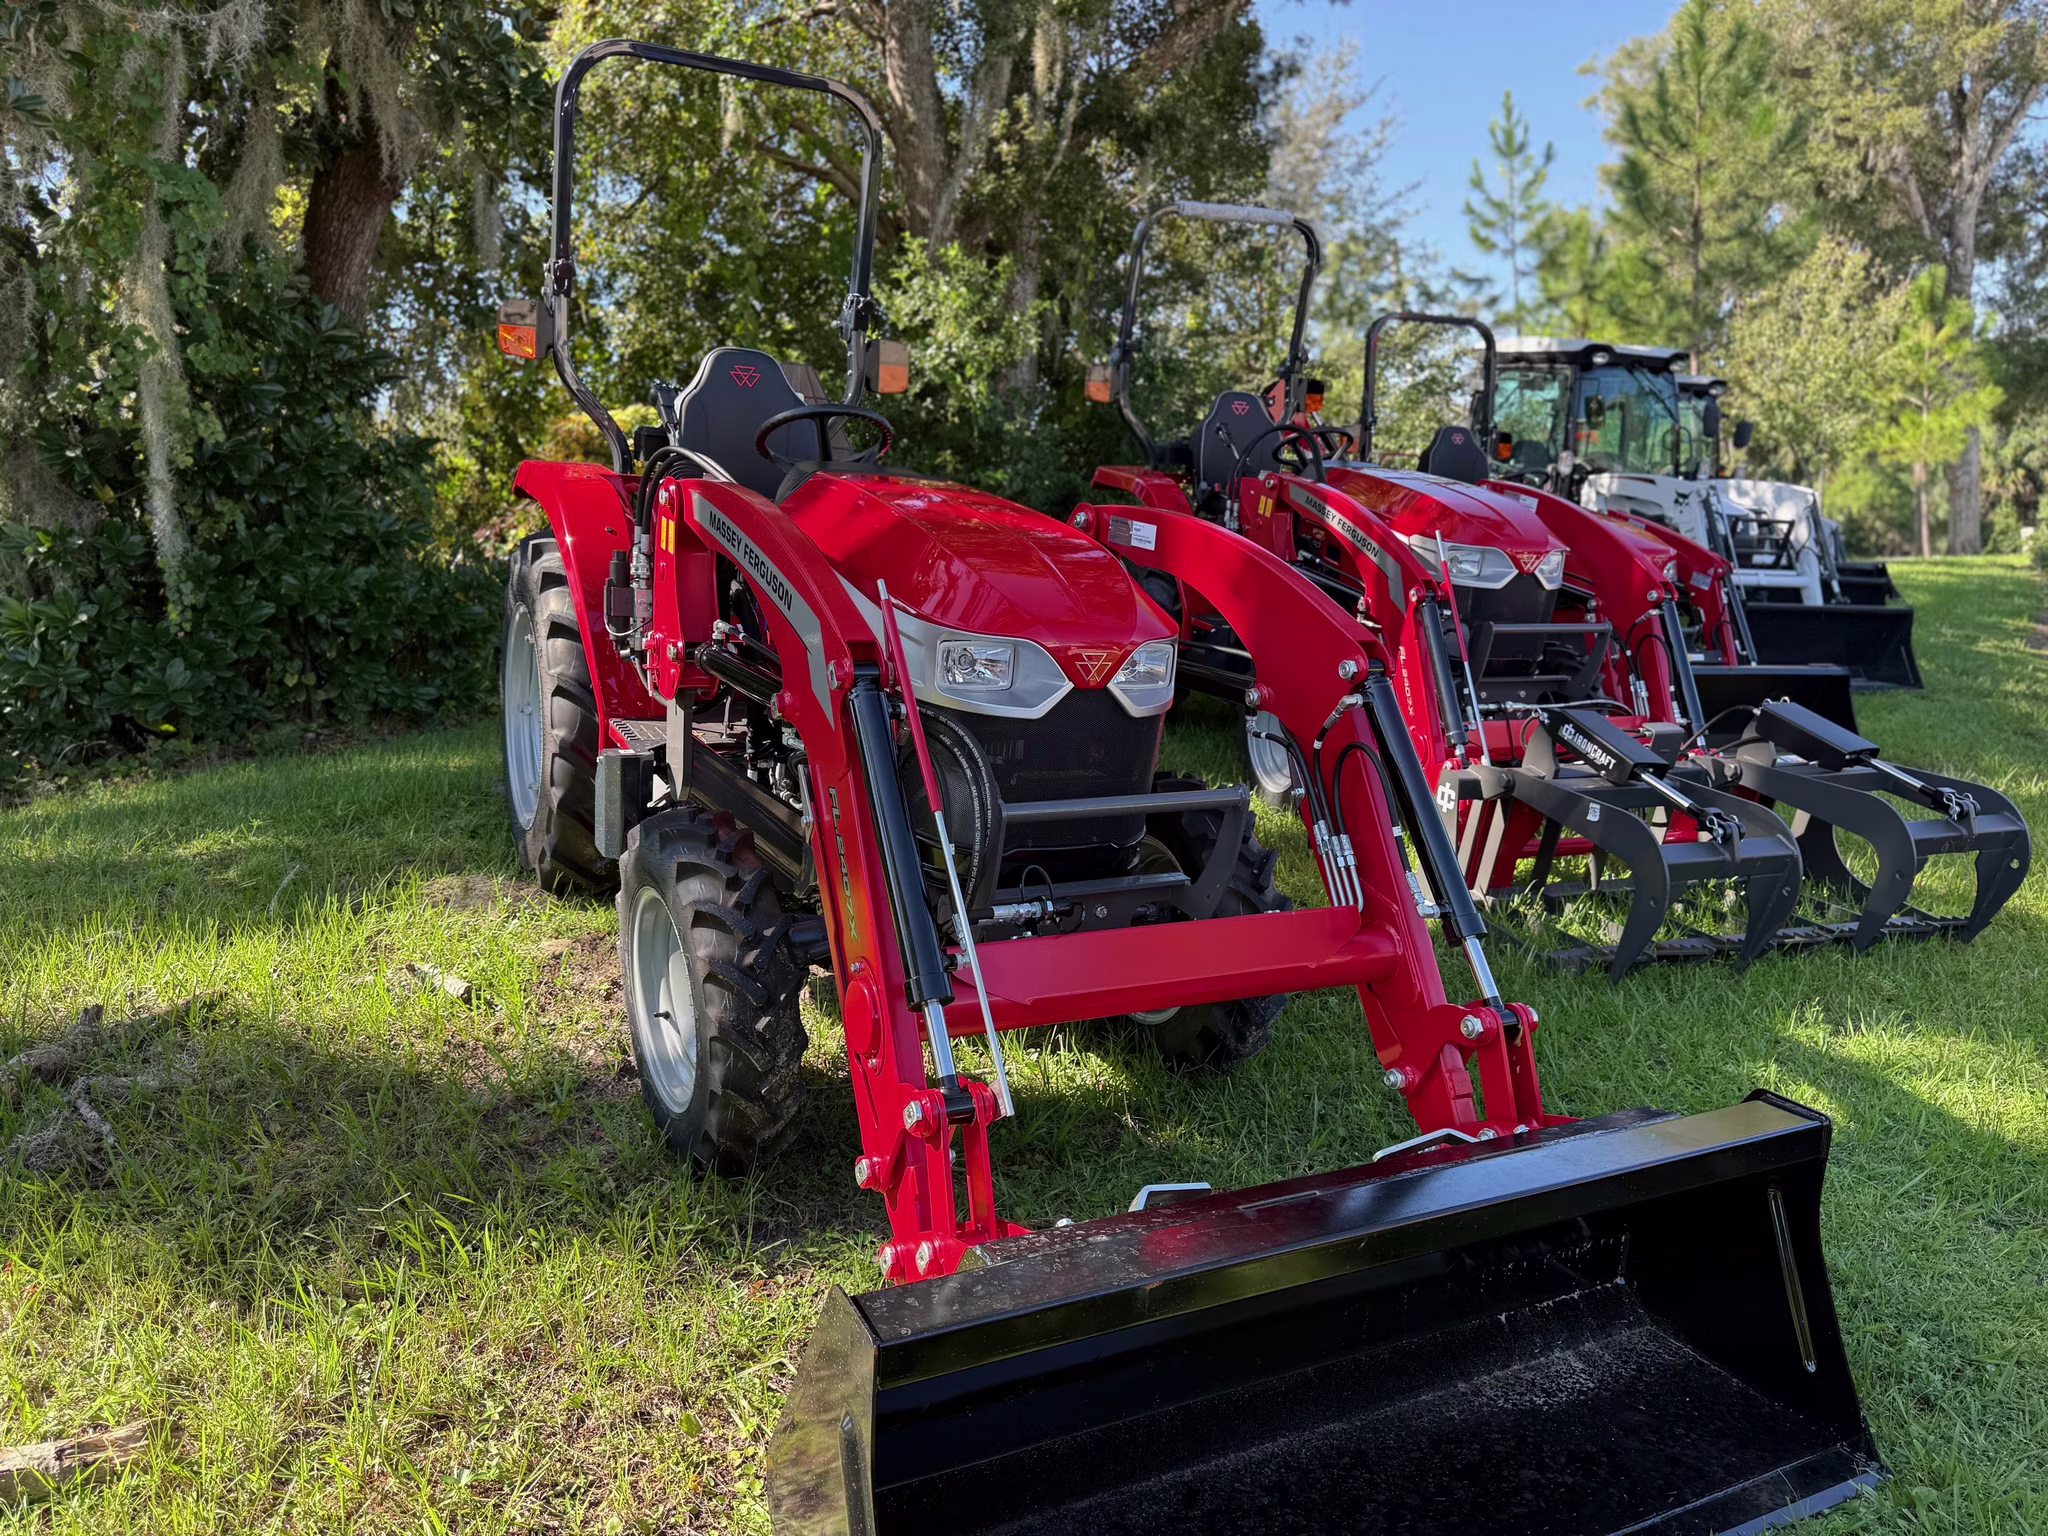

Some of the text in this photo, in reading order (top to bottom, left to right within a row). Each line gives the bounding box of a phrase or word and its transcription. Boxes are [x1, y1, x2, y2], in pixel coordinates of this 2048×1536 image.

[709, 510, 793, 612] MASSEY FERGUSON
[1305, 496, 1379, 558] MASSEY FERGUSON
[1573, 733, 1617, 770] IRONCRAFT
[828, 785, 859, 944] FL.2407X
